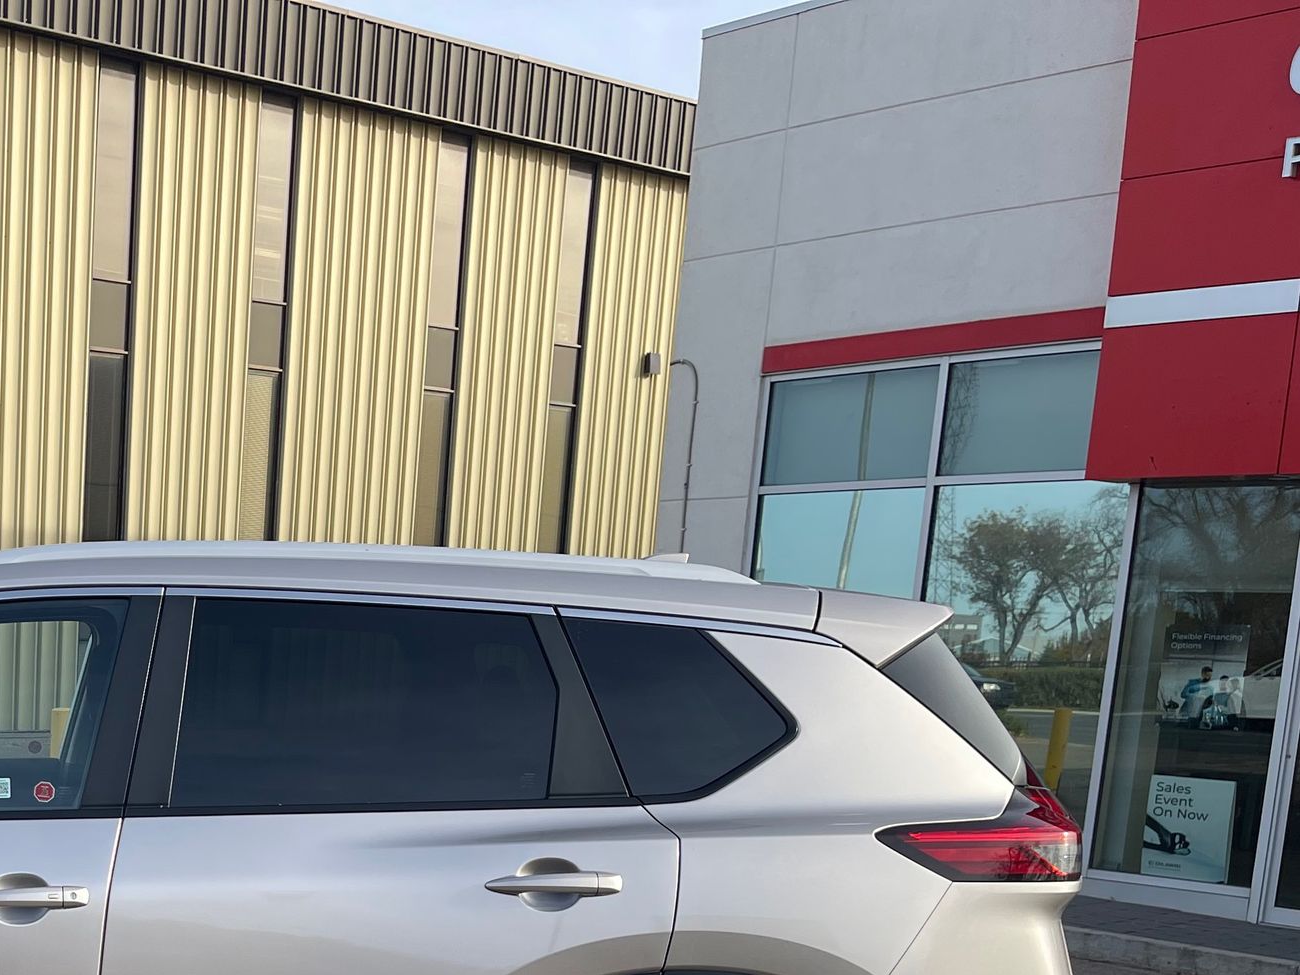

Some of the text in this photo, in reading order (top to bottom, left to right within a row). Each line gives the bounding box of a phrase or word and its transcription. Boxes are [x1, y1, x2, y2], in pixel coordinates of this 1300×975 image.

[1172, 632, 1243, 642] Flexible Financing
[1170, 641, 1202, 650] Options
[1156, 781, 1192, 794] Sales
[1154, 794, 1194, 807] Event
[1153, 806, 1208, 821] On Now
